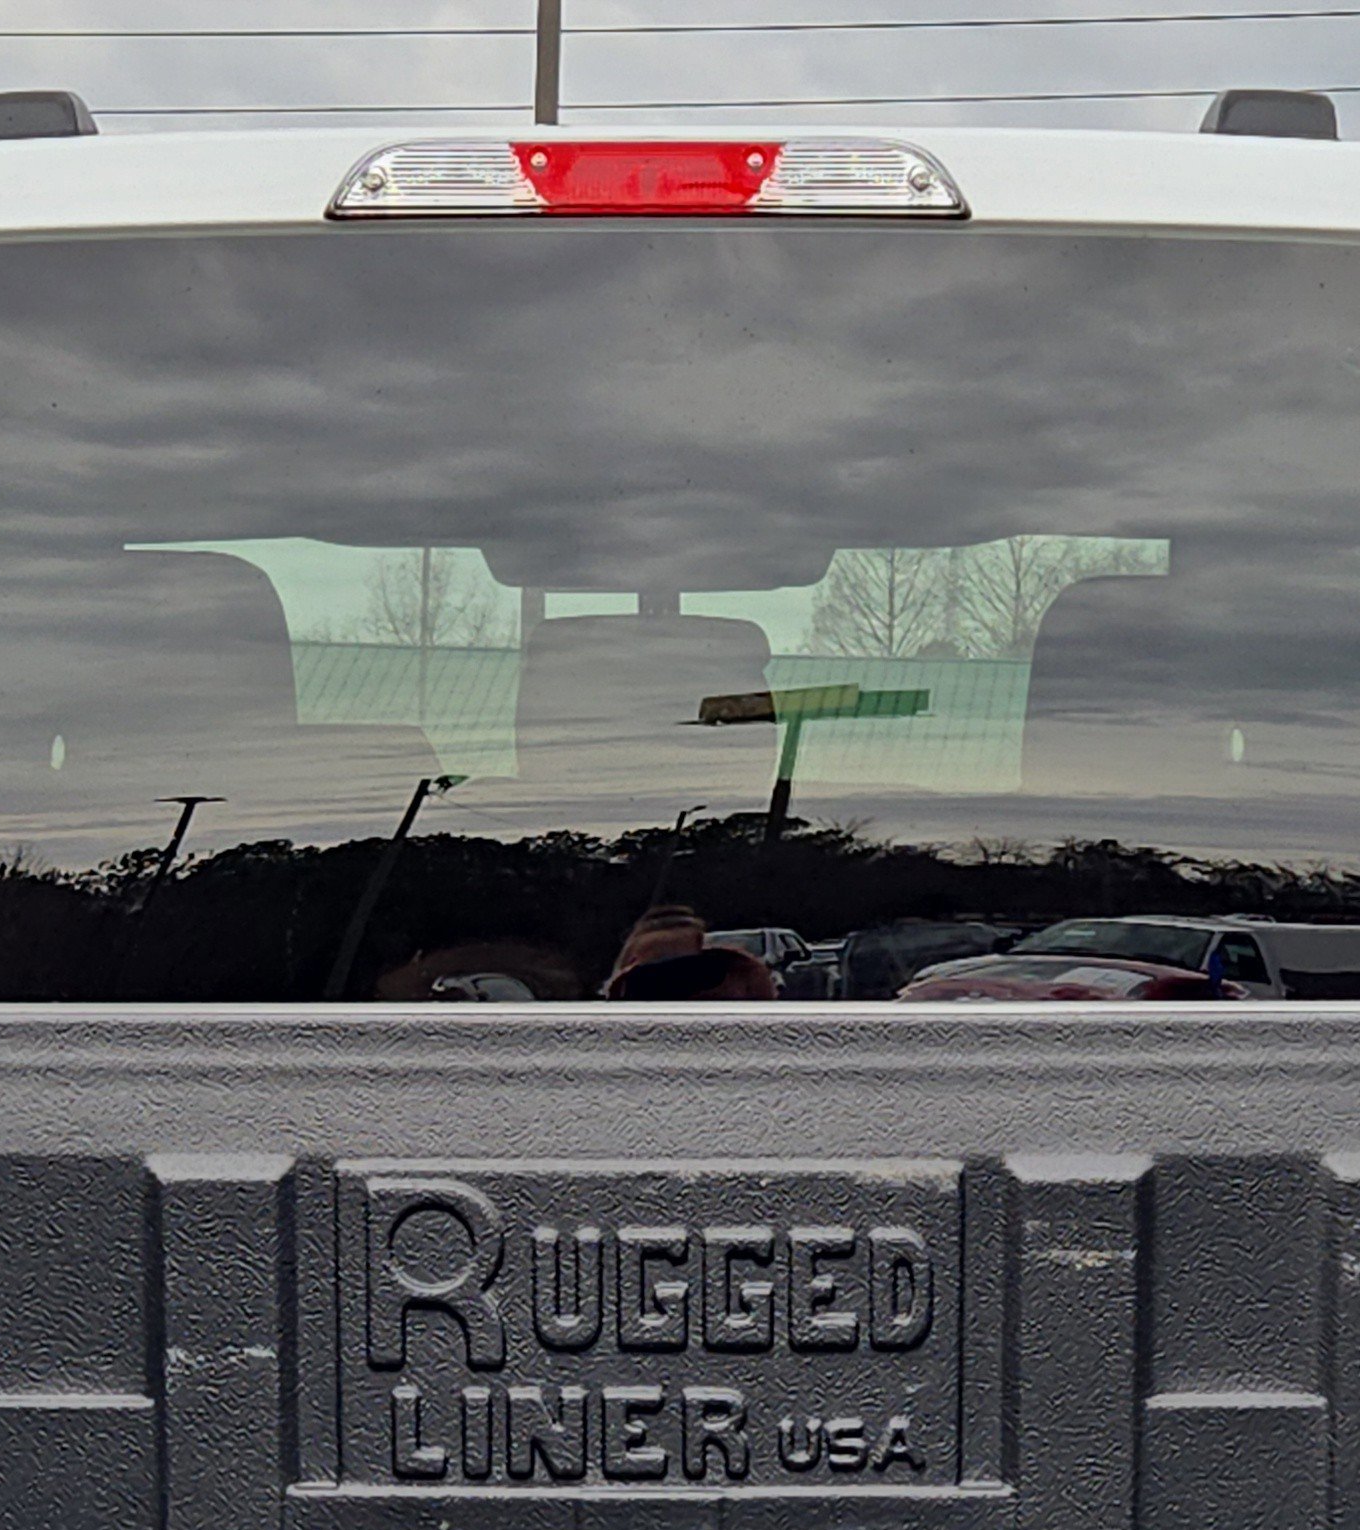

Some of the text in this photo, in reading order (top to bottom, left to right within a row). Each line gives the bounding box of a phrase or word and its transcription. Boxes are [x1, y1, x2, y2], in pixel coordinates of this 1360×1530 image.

[367, 1177, 934, 1372] RUGGED
[392, 1386, 927, 1481] LINER USA
